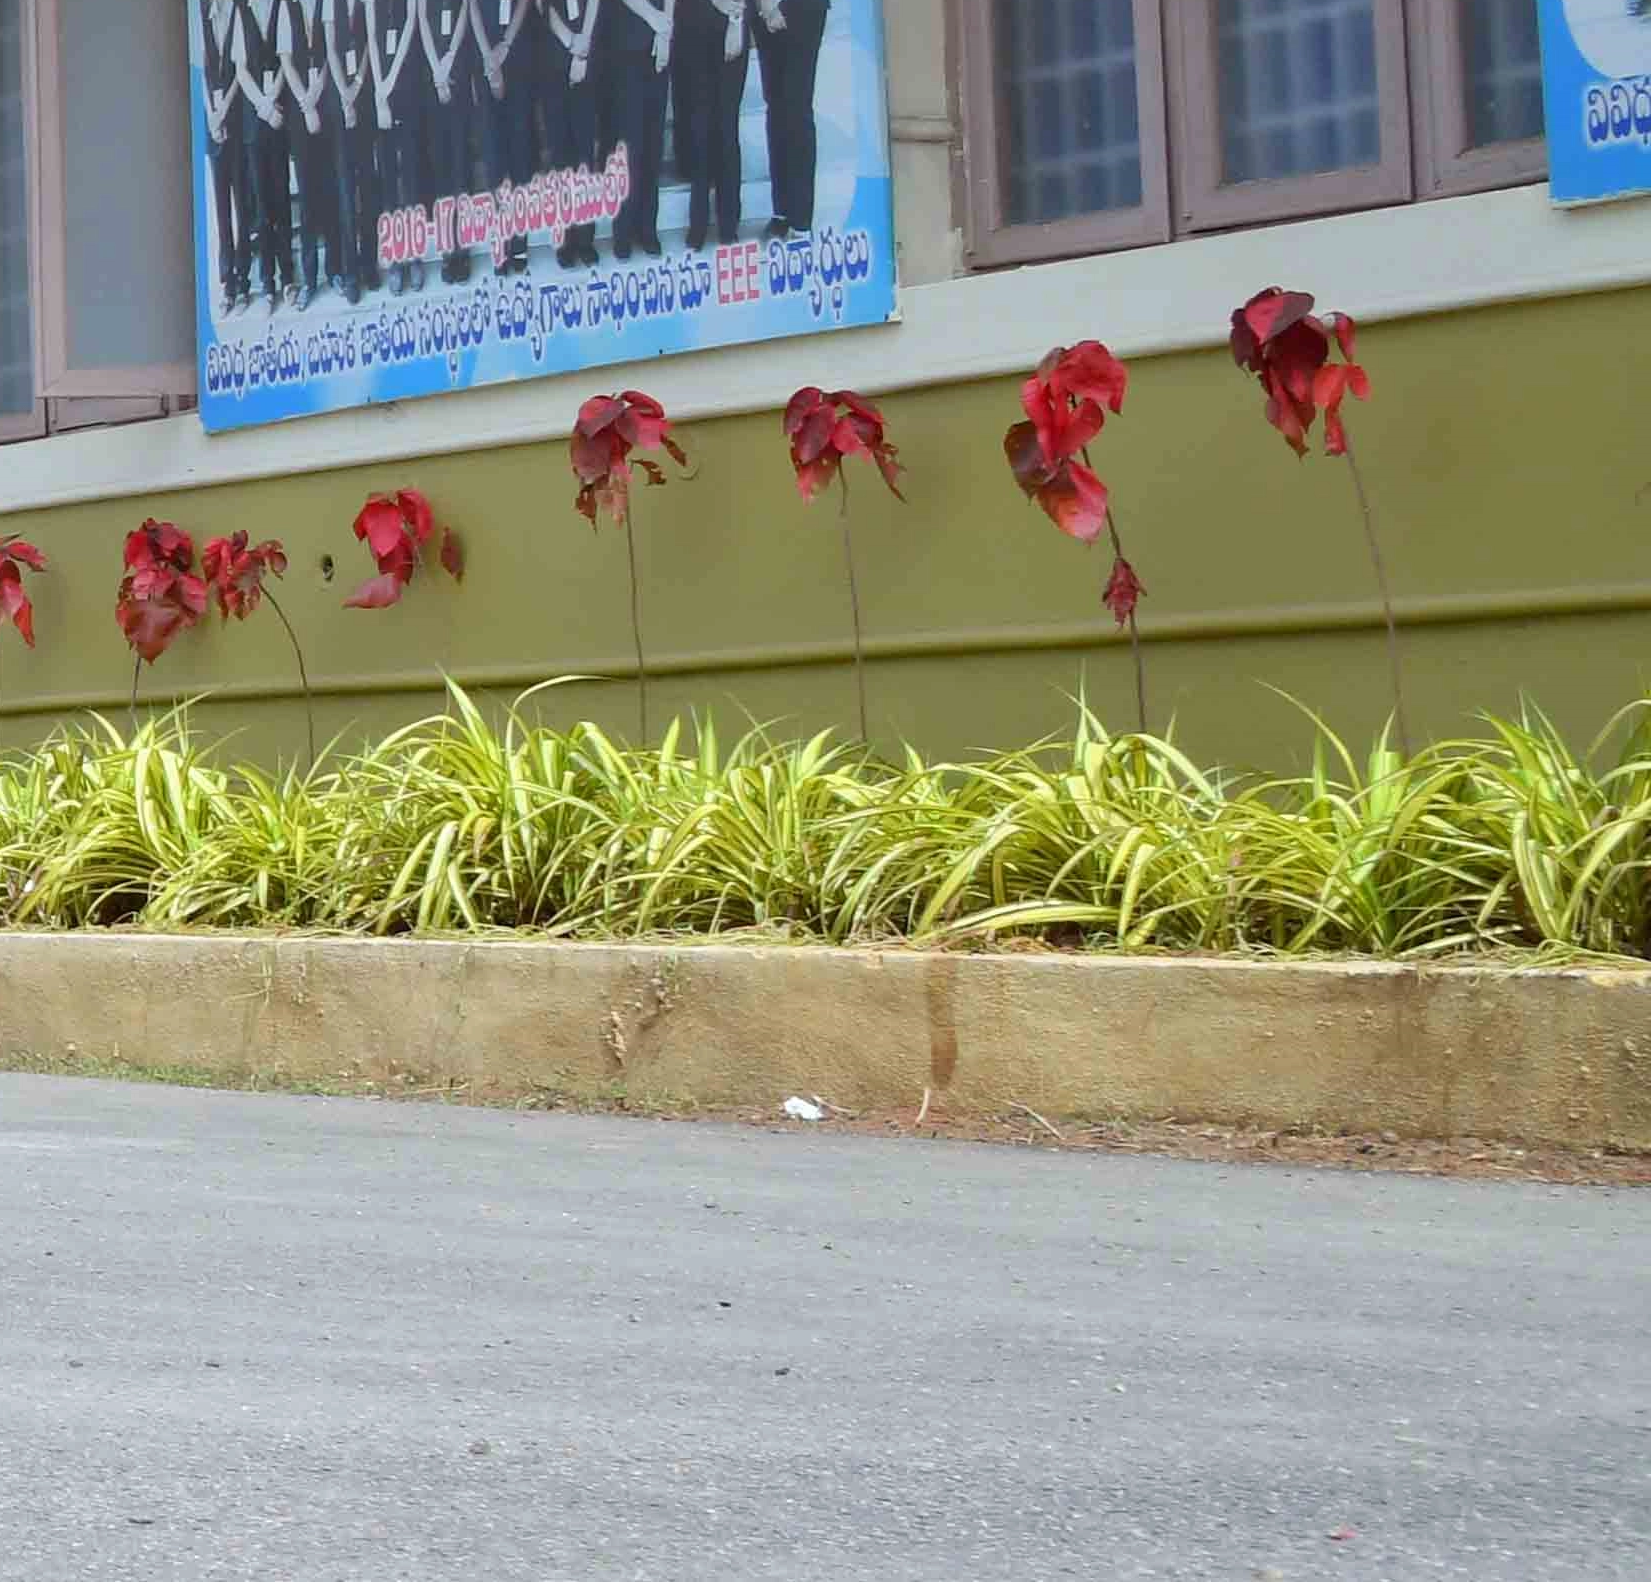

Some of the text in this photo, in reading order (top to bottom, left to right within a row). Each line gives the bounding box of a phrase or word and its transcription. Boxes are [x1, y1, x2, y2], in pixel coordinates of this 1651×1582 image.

[379, 196, 455, 264] 2016-17
[207, 338, 245, 396] వివిధ
[679, 253, 711, 310] మా
[717, 243, 760, 304] EEE
